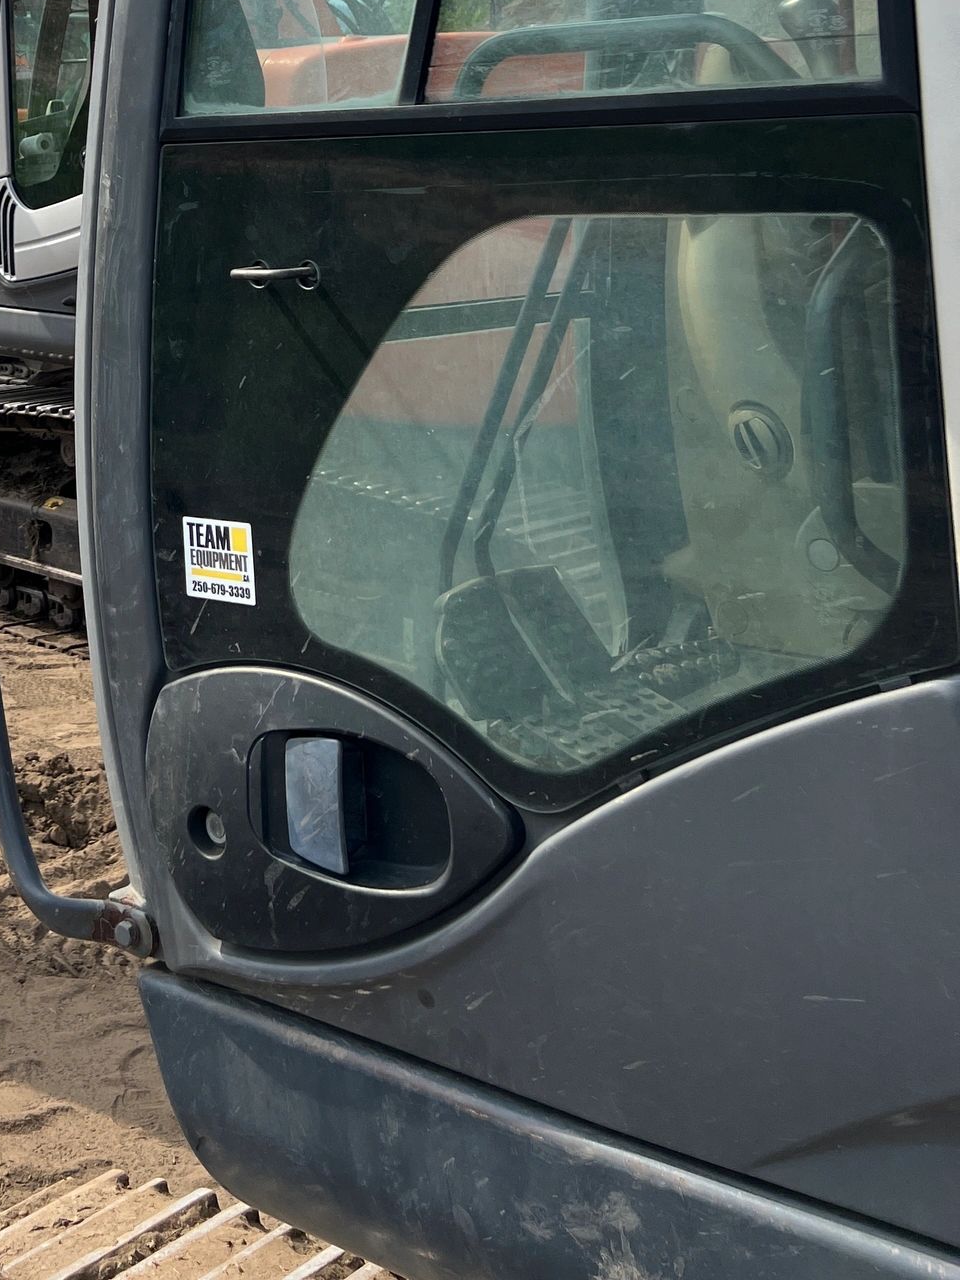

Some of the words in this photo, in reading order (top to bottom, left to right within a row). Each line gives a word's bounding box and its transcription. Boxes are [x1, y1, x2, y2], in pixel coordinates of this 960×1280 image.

[187, 522, 231, 551] TEAM
[190, 548, 248, 572] EQUIPMENT
[192, 580, 251, 599] 250-679-3339
